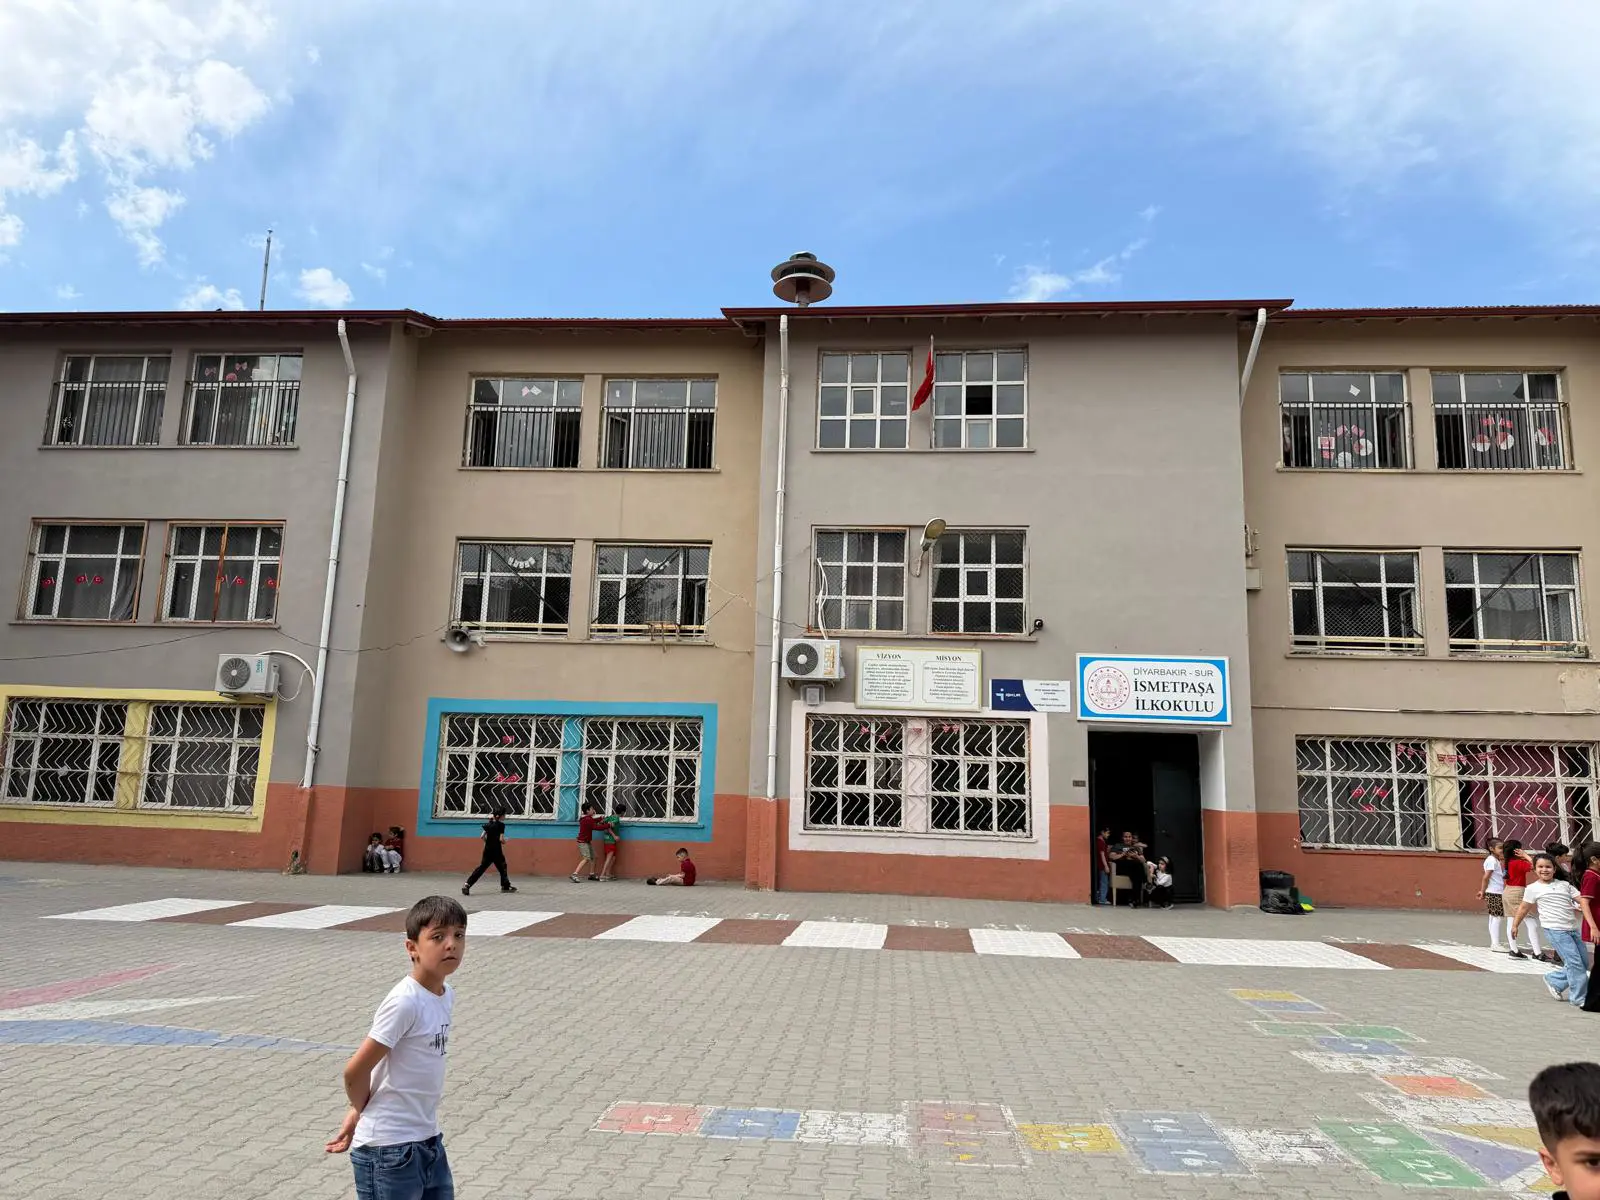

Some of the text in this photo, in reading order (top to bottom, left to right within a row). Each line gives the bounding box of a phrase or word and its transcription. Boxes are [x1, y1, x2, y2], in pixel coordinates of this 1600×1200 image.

[1133, 667, 1187, 676] DİYARBAKIR
[1195, 669, 1214, 677] SUR
[1134, 678, 1215, 697] İSMETPAŞA
[1135, 696, 1214, 713] İLKOKULU
